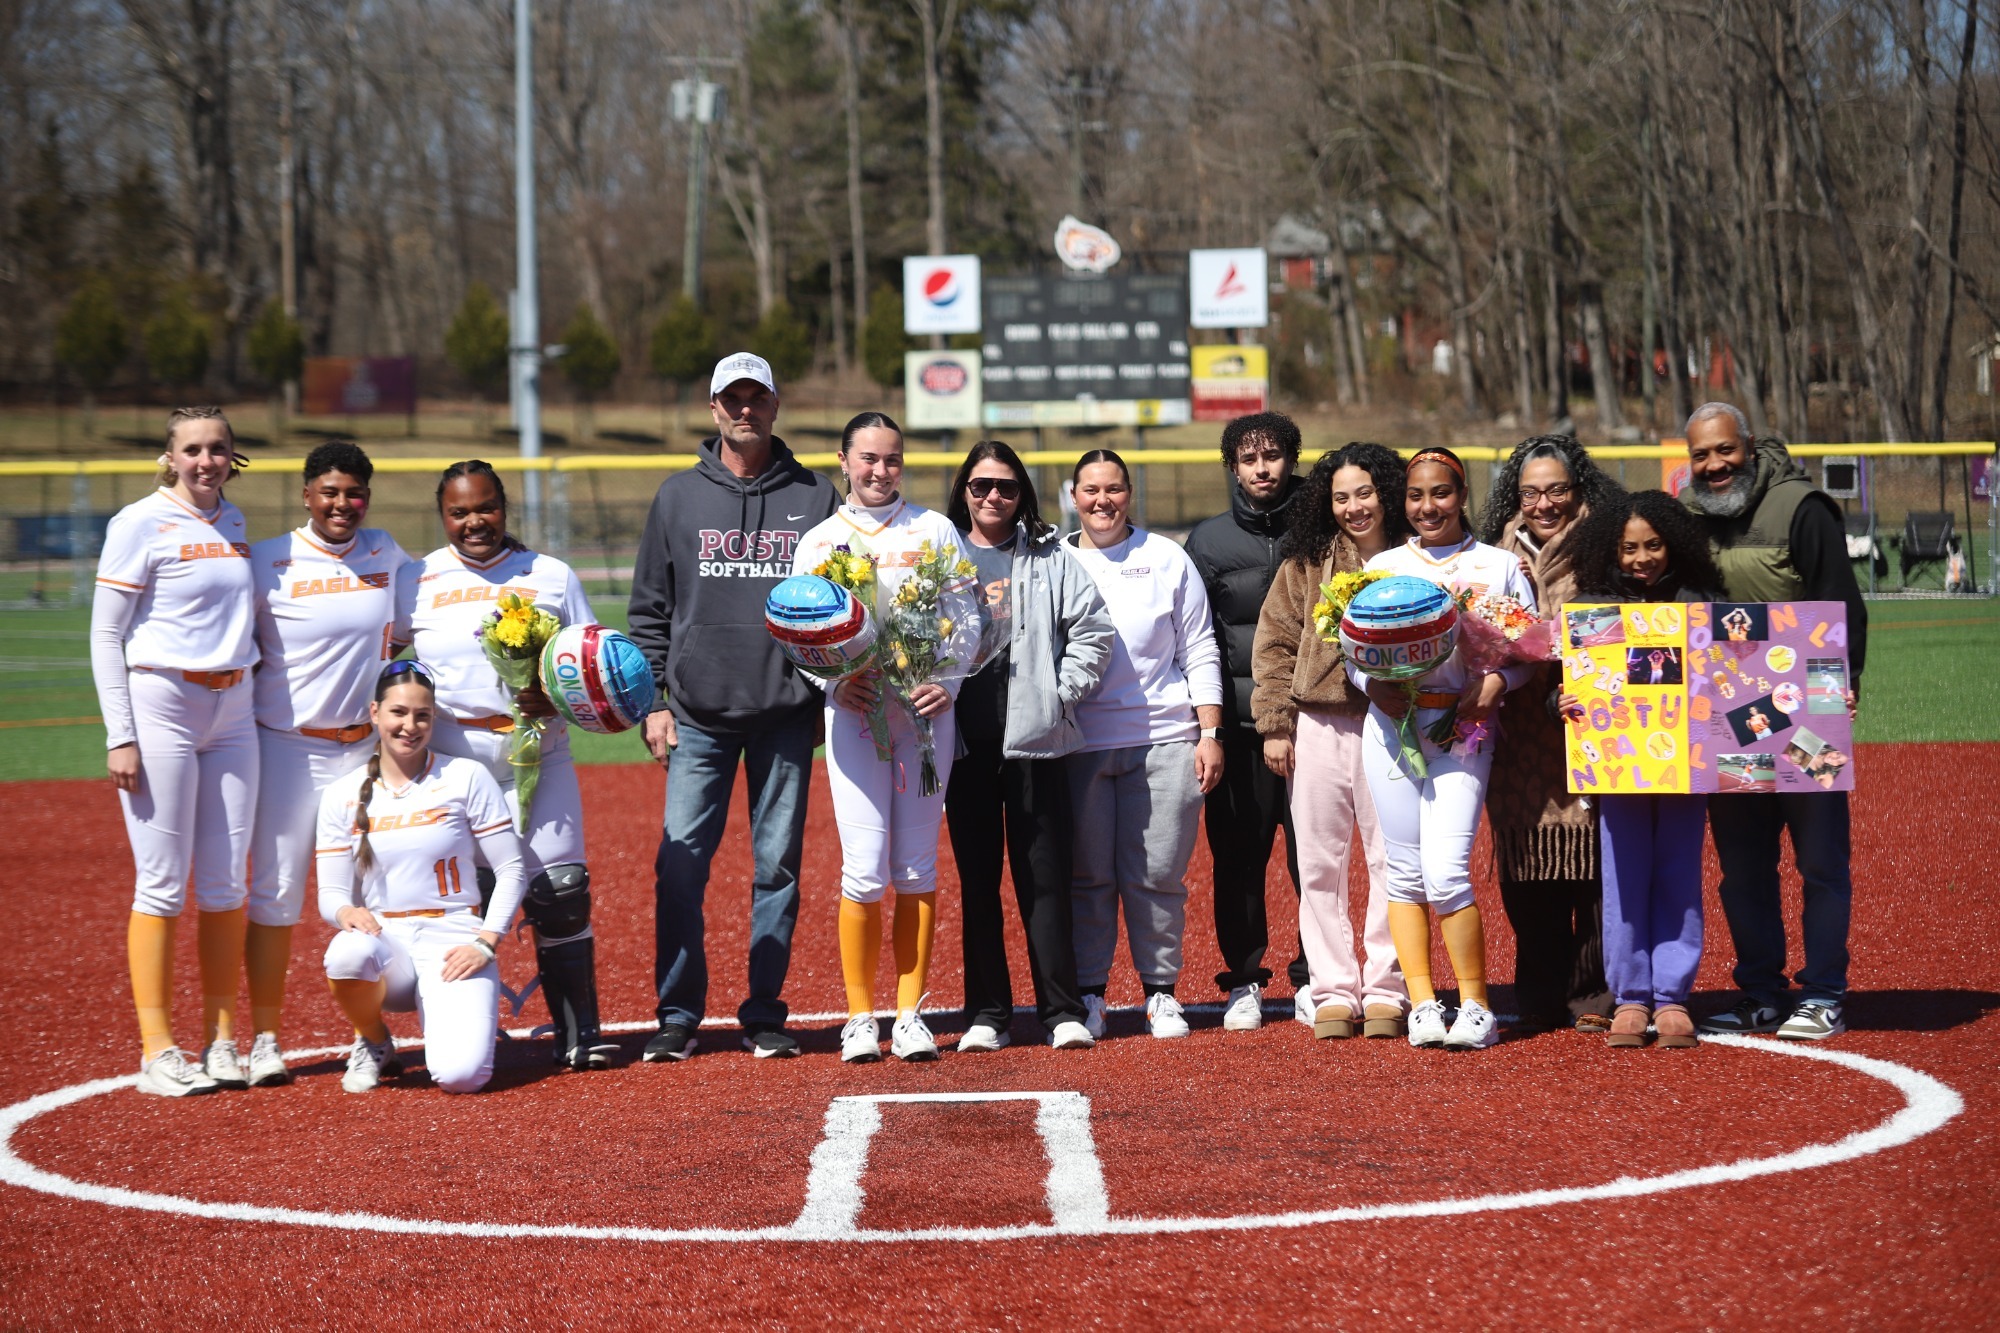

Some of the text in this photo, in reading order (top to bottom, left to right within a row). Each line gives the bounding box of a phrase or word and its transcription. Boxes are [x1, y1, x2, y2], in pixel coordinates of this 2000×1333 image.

[180, 542, 252, 561] EAGLES
[699, 529, 799, 561] POST
[290, 571, 389, 599] EAGLES
[431, 586, 539, 609] EAGLES
[1769, 604, 1846, 649] NYLA
[1687, 603, 1712, 793] SOFTBALL
[1572, 763, 1678, 791] NYLA
[433, 856, 461, 897] 11
